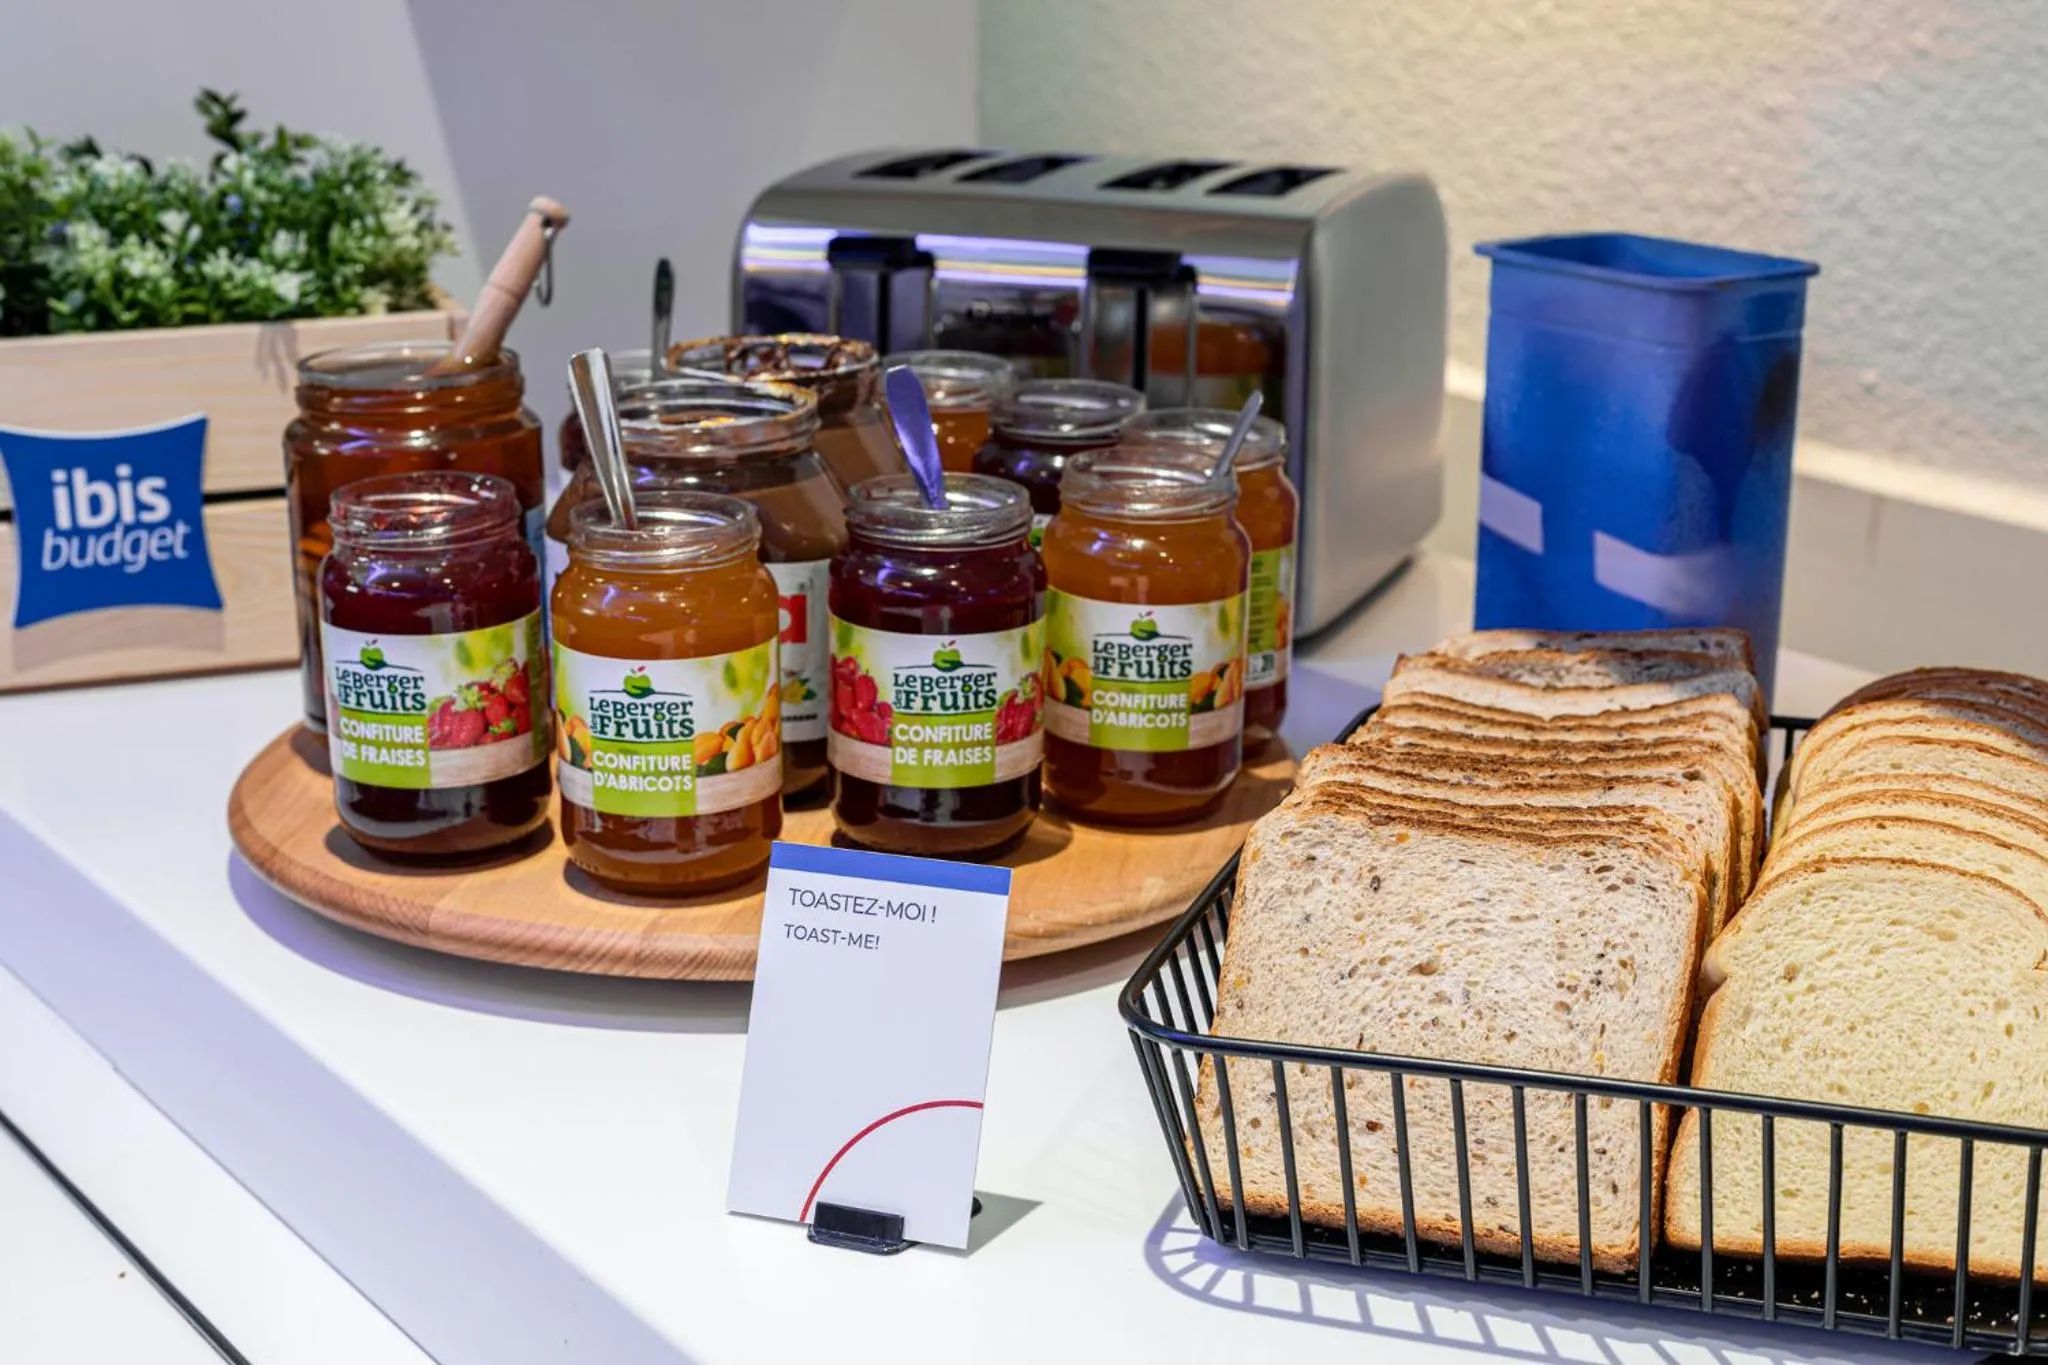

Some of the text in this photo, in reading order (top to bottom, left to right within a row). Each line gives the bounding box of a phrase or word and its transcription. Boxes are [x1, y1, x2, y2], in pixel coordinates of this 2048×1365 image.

[51, 464, 171, 530] ibis
[41, 519, 191, 574] budget
[1093, 640, 1193, 663] Le Berger
[1102, 656, 1193, 679] Fruits
[352, 671, 425, 694] Berger
[893, 672, 998, 693] Le Berger
[342, 684, 427, 712] Fruits
[589, 697, 694, 720] Le Berger
[902, 688, 998, 711] Fruits
[1092, 689, 1188, 710] CONFITURE
[599, 715, 695, 740] Fruits
[1092, 709, 1188, 729] D'ABRICOTS
[340, 717, 425, 745] CONFITURE
[895, 723, 993, 743] CONFITURE
[342, 740, 426, 767] DE FRAISES
[592, 750, 693, 772] CONFITURE
[895, 747, 992, 767] DE FRAISES
[593, 772, 693, 793] D'ABRICOTS
[783, 923, 881, 950] TOAST-ME!
